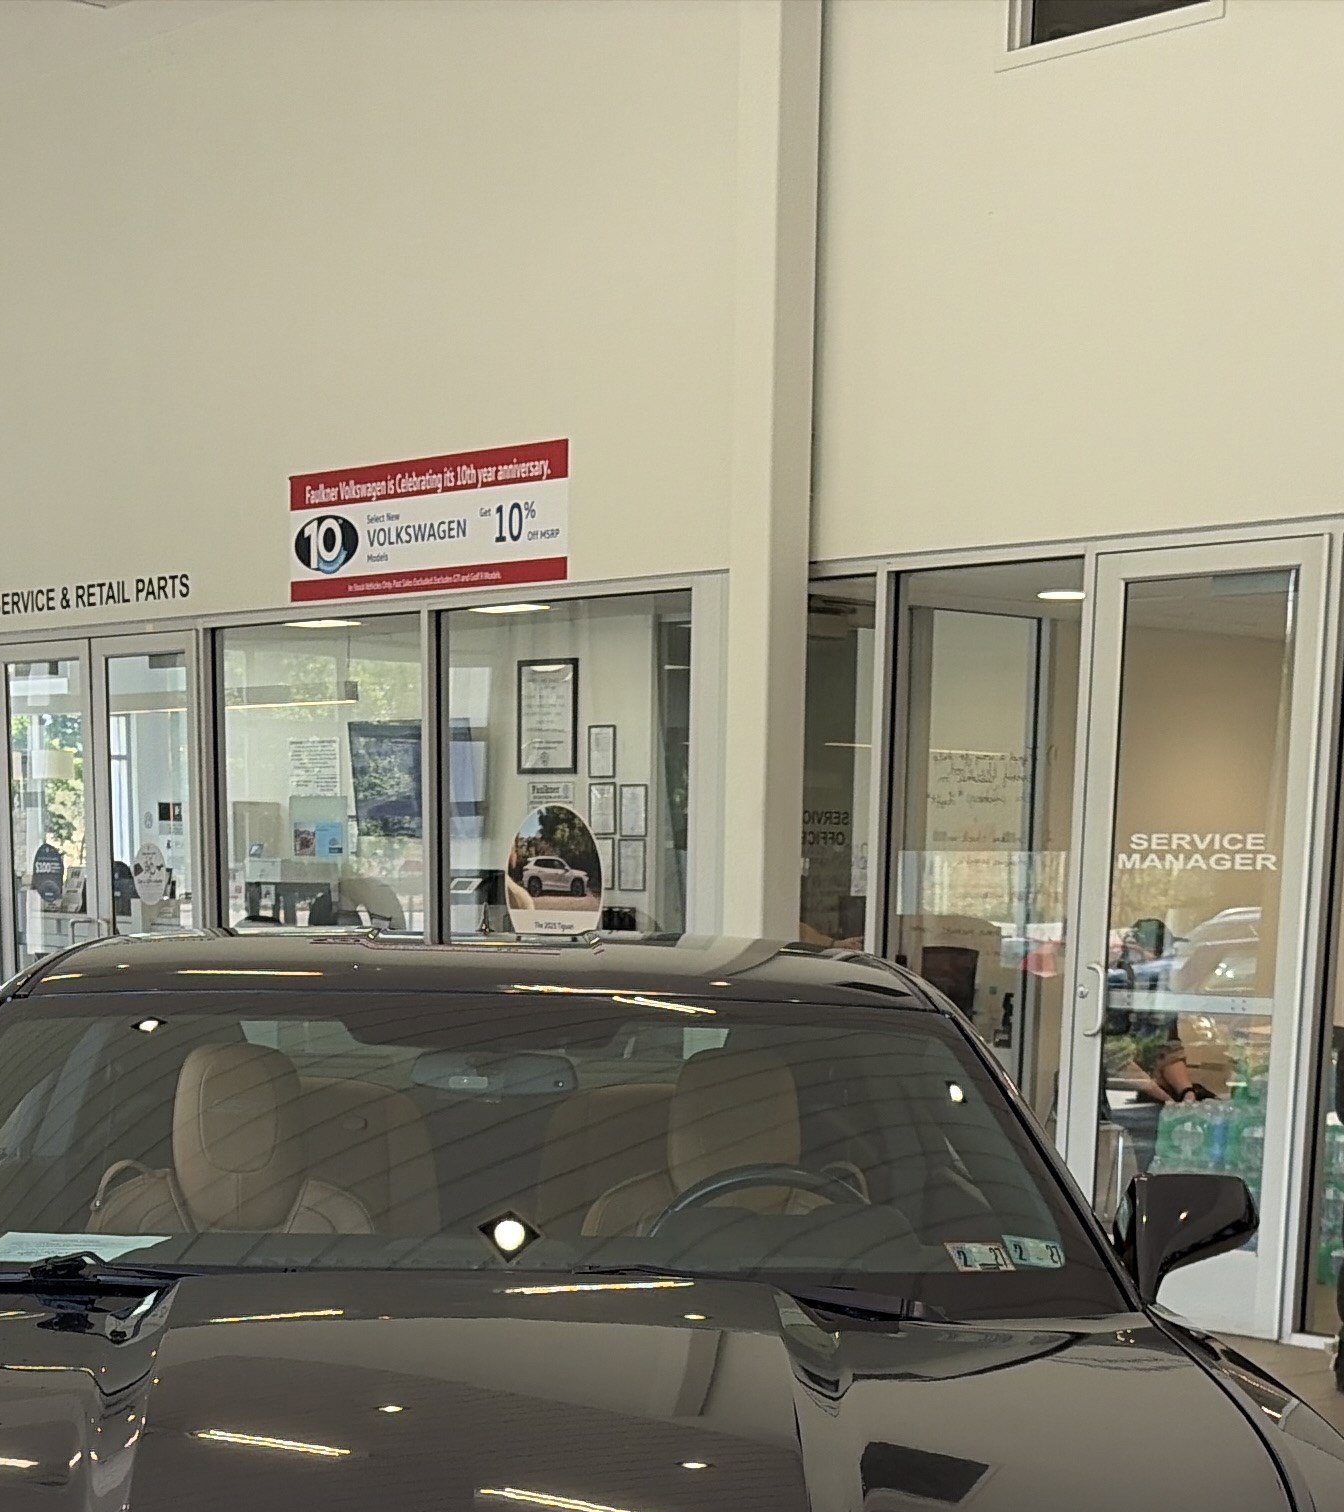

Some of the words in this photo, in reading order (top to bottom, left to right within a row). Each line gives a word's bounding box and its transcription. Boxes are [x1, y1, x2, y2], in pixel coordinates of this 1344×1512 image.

[305, 484, 338, 504] Faulkner
[339, 479, 386, 501] Volkswagen
[387, 475, 394, 494] is
[396, 468, 442, 493] Celebrating
[456, 464, 476, 485] 10th
[477, 466, 496, 488] year
[367, 514, 385, 524] Select
[386, 512, 400, 522] New
[367, 518, 467, 547] VOLKSWAGEN
[60, 586, 70, 609] &
[75, 580, 131, 608] RETAIL
[135, 573, 190, 602] PARTS
[1129, 833, 1265, 851] SERVICE
[1117, 853, 1277, 871] MANAGER
